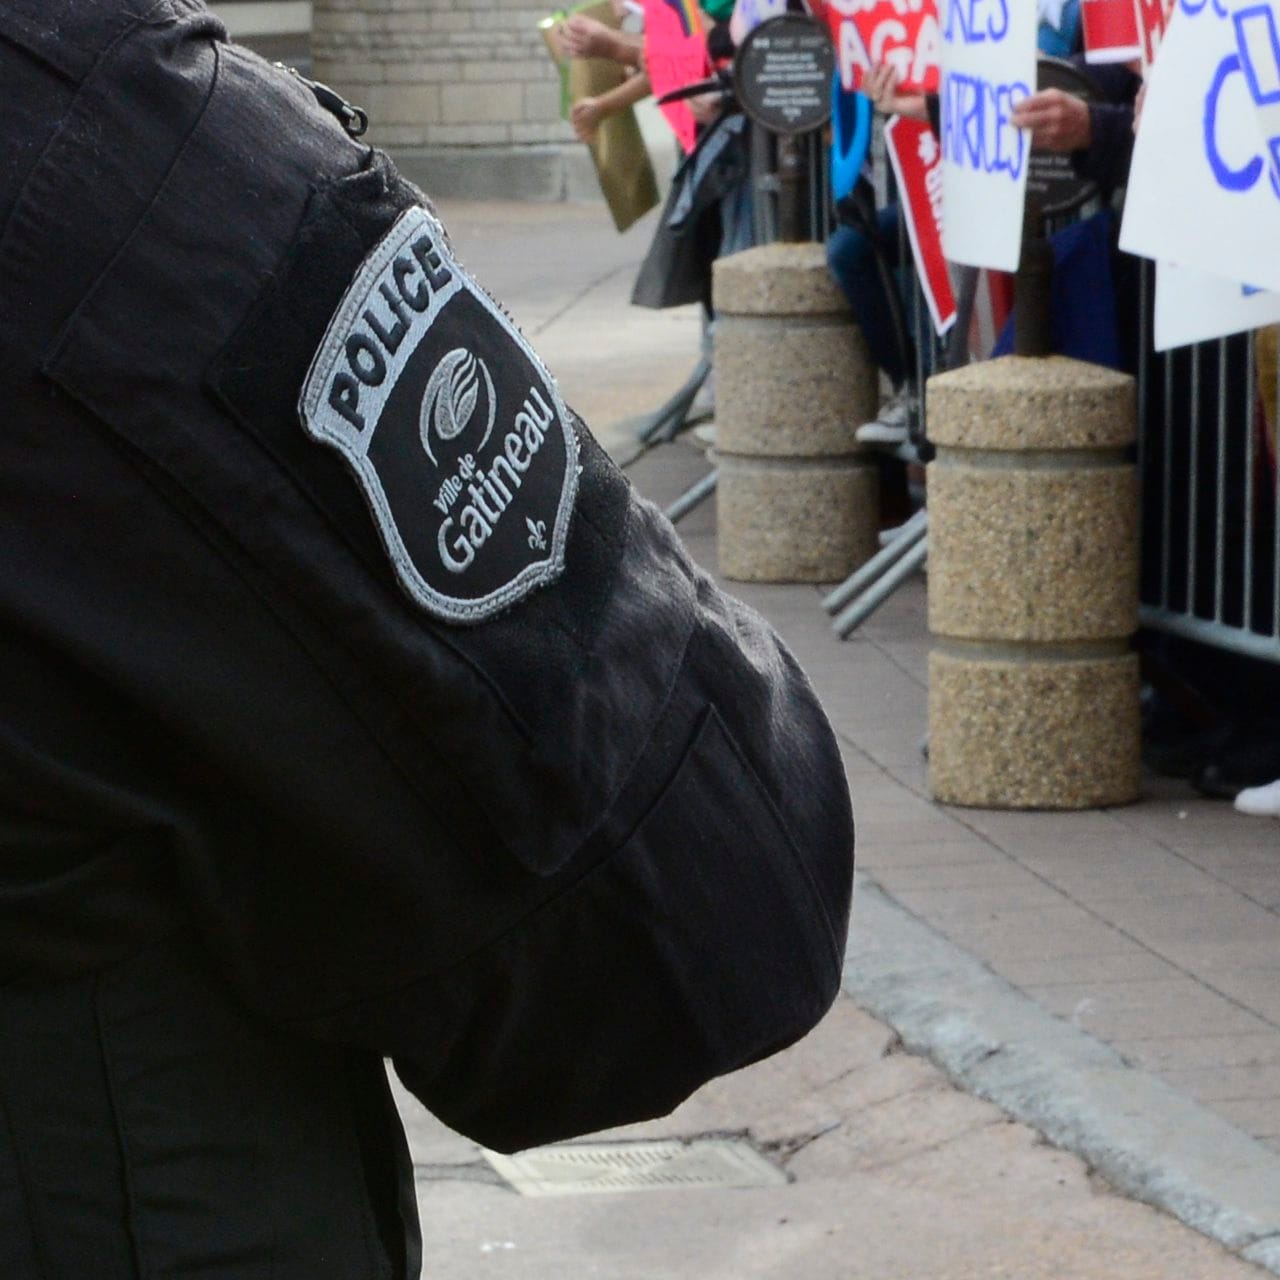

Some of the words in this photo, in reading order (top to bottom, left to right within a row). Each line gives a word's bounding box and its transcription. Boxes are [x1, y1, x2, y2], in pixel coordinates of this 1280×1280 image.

[328, 234, 453, 433] POLICE
[438, 387, 555, 573] Gatineau
[457, 453, 476, 480] de
